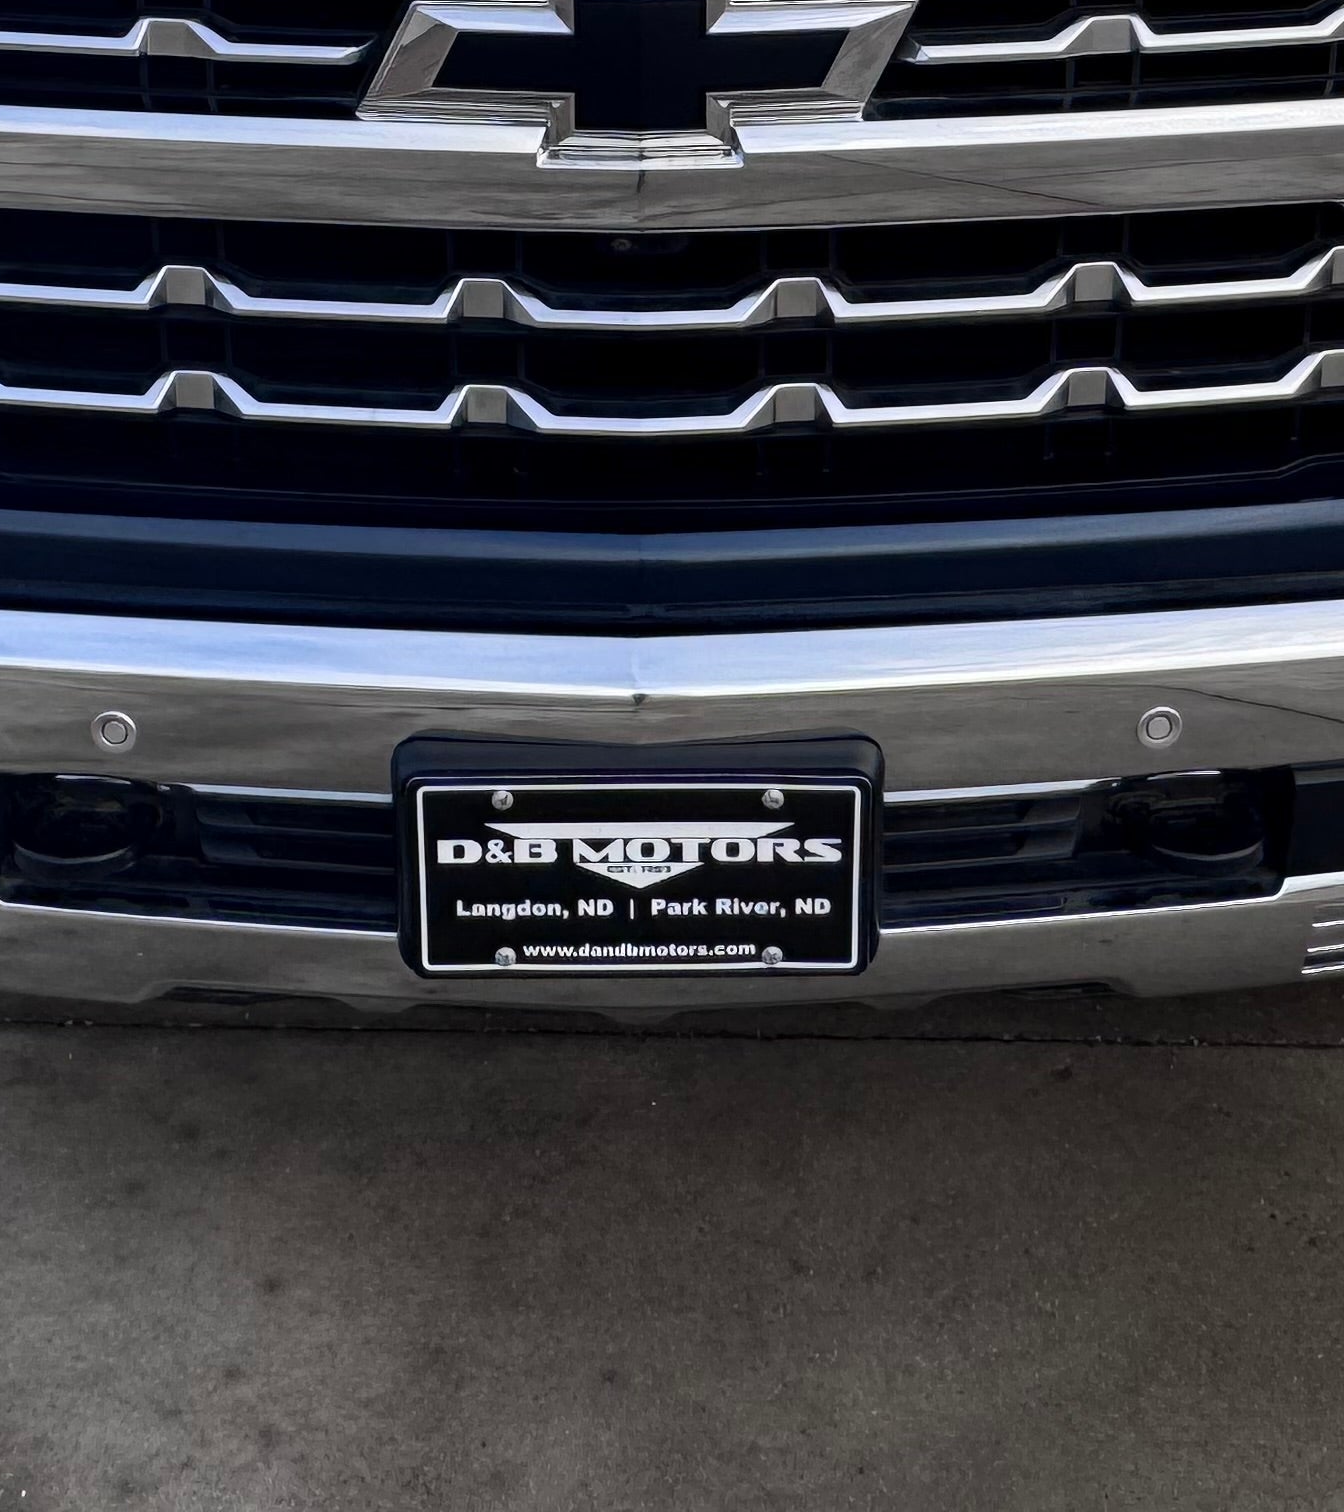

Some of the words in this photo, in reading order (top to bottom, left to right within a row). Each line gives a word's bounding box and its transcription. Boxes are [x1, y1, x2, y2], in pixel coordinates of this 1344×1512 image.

[437, 839, 558, 864] D&B
[572, 838, 842, 864] MOTORS
[456, 899, 569, 920] Langdon,
[577, 898, 614, 917] ND
[651, 898, 708, 916] Park
[715, 897, 787, 918] River,
[794, 897, 831, 916] ND
[522, 942, 756, 958] www.dandbmotors.com
